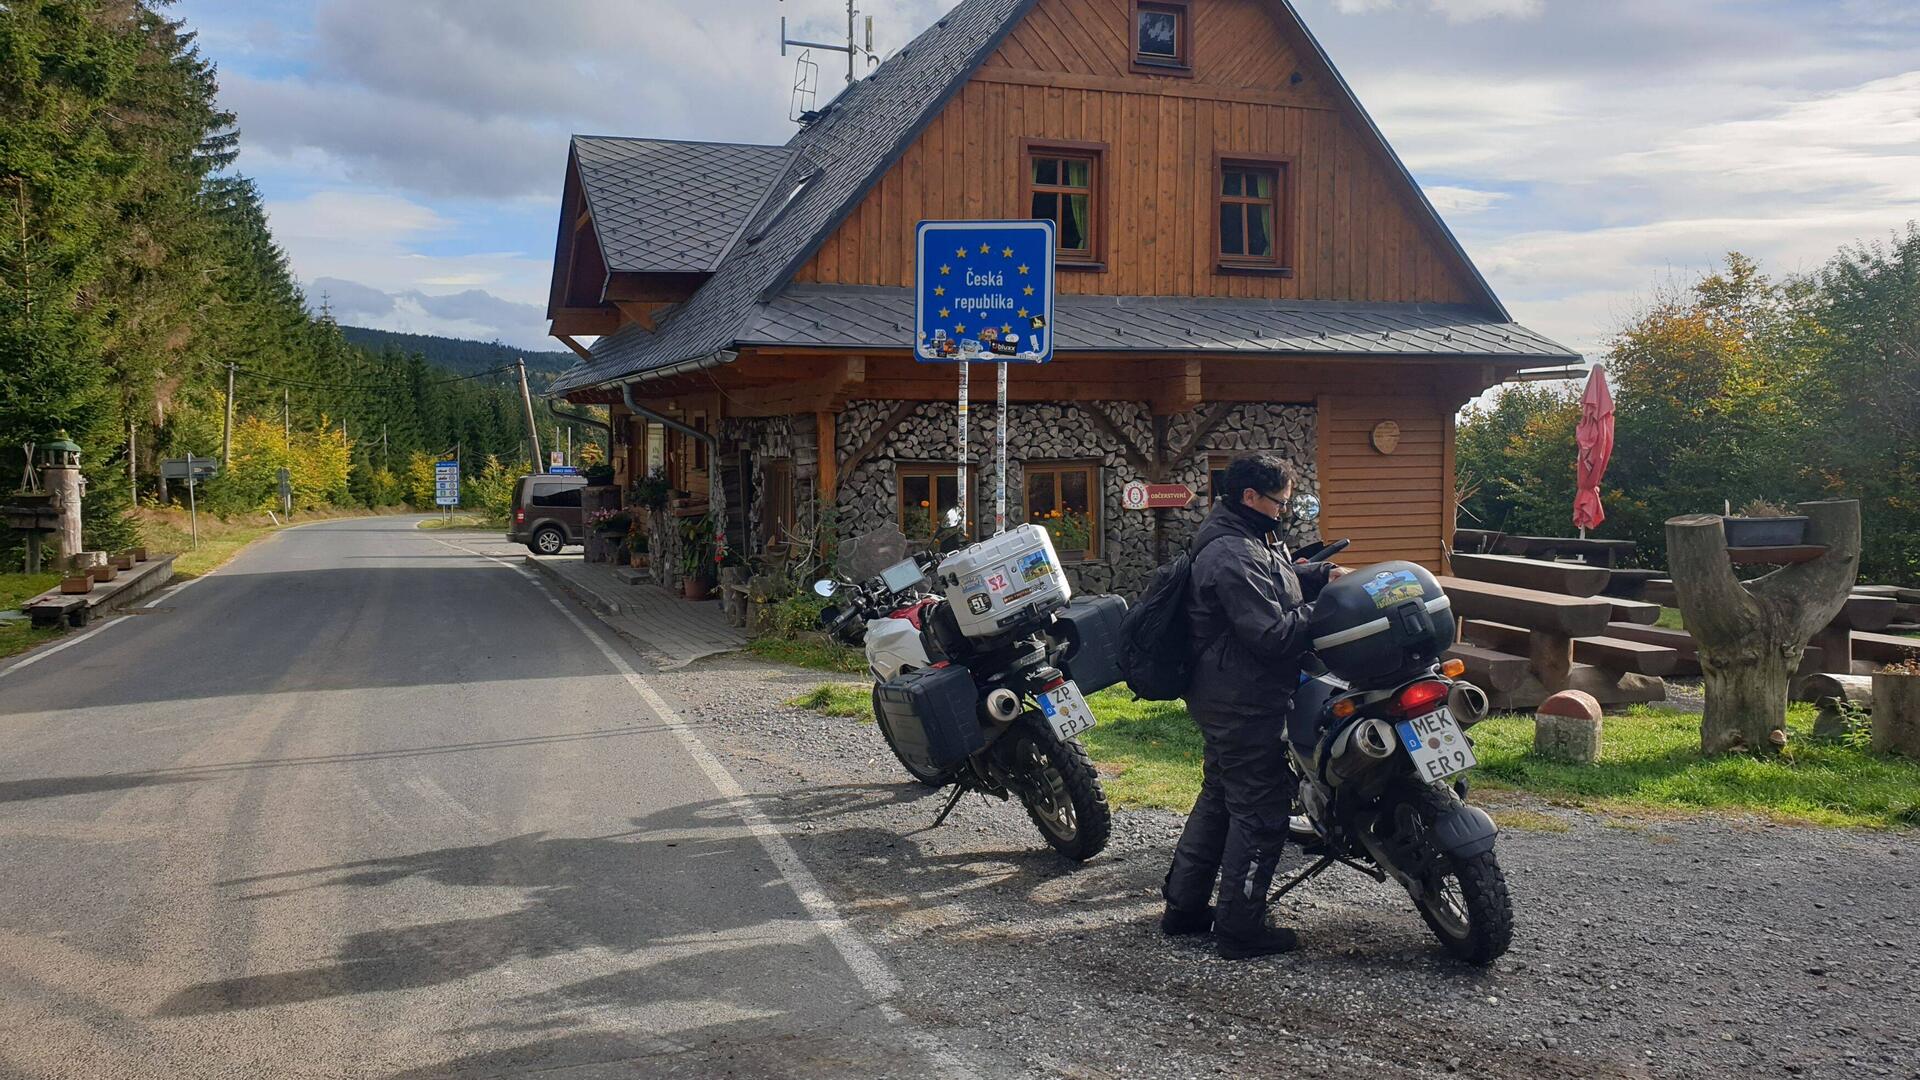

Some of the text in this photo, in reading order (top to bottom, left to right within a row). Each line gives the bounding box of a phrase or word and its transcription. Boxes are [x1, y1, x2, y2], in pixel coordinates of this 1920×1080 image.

[966, 267, 1003, 286] Česká
[955, 294, 1014, 313] republika
[971, 596, 986, 610] 51
[1052, 686, 1072, 704] ZP
[1411, 709, 1453, 737] MEK
